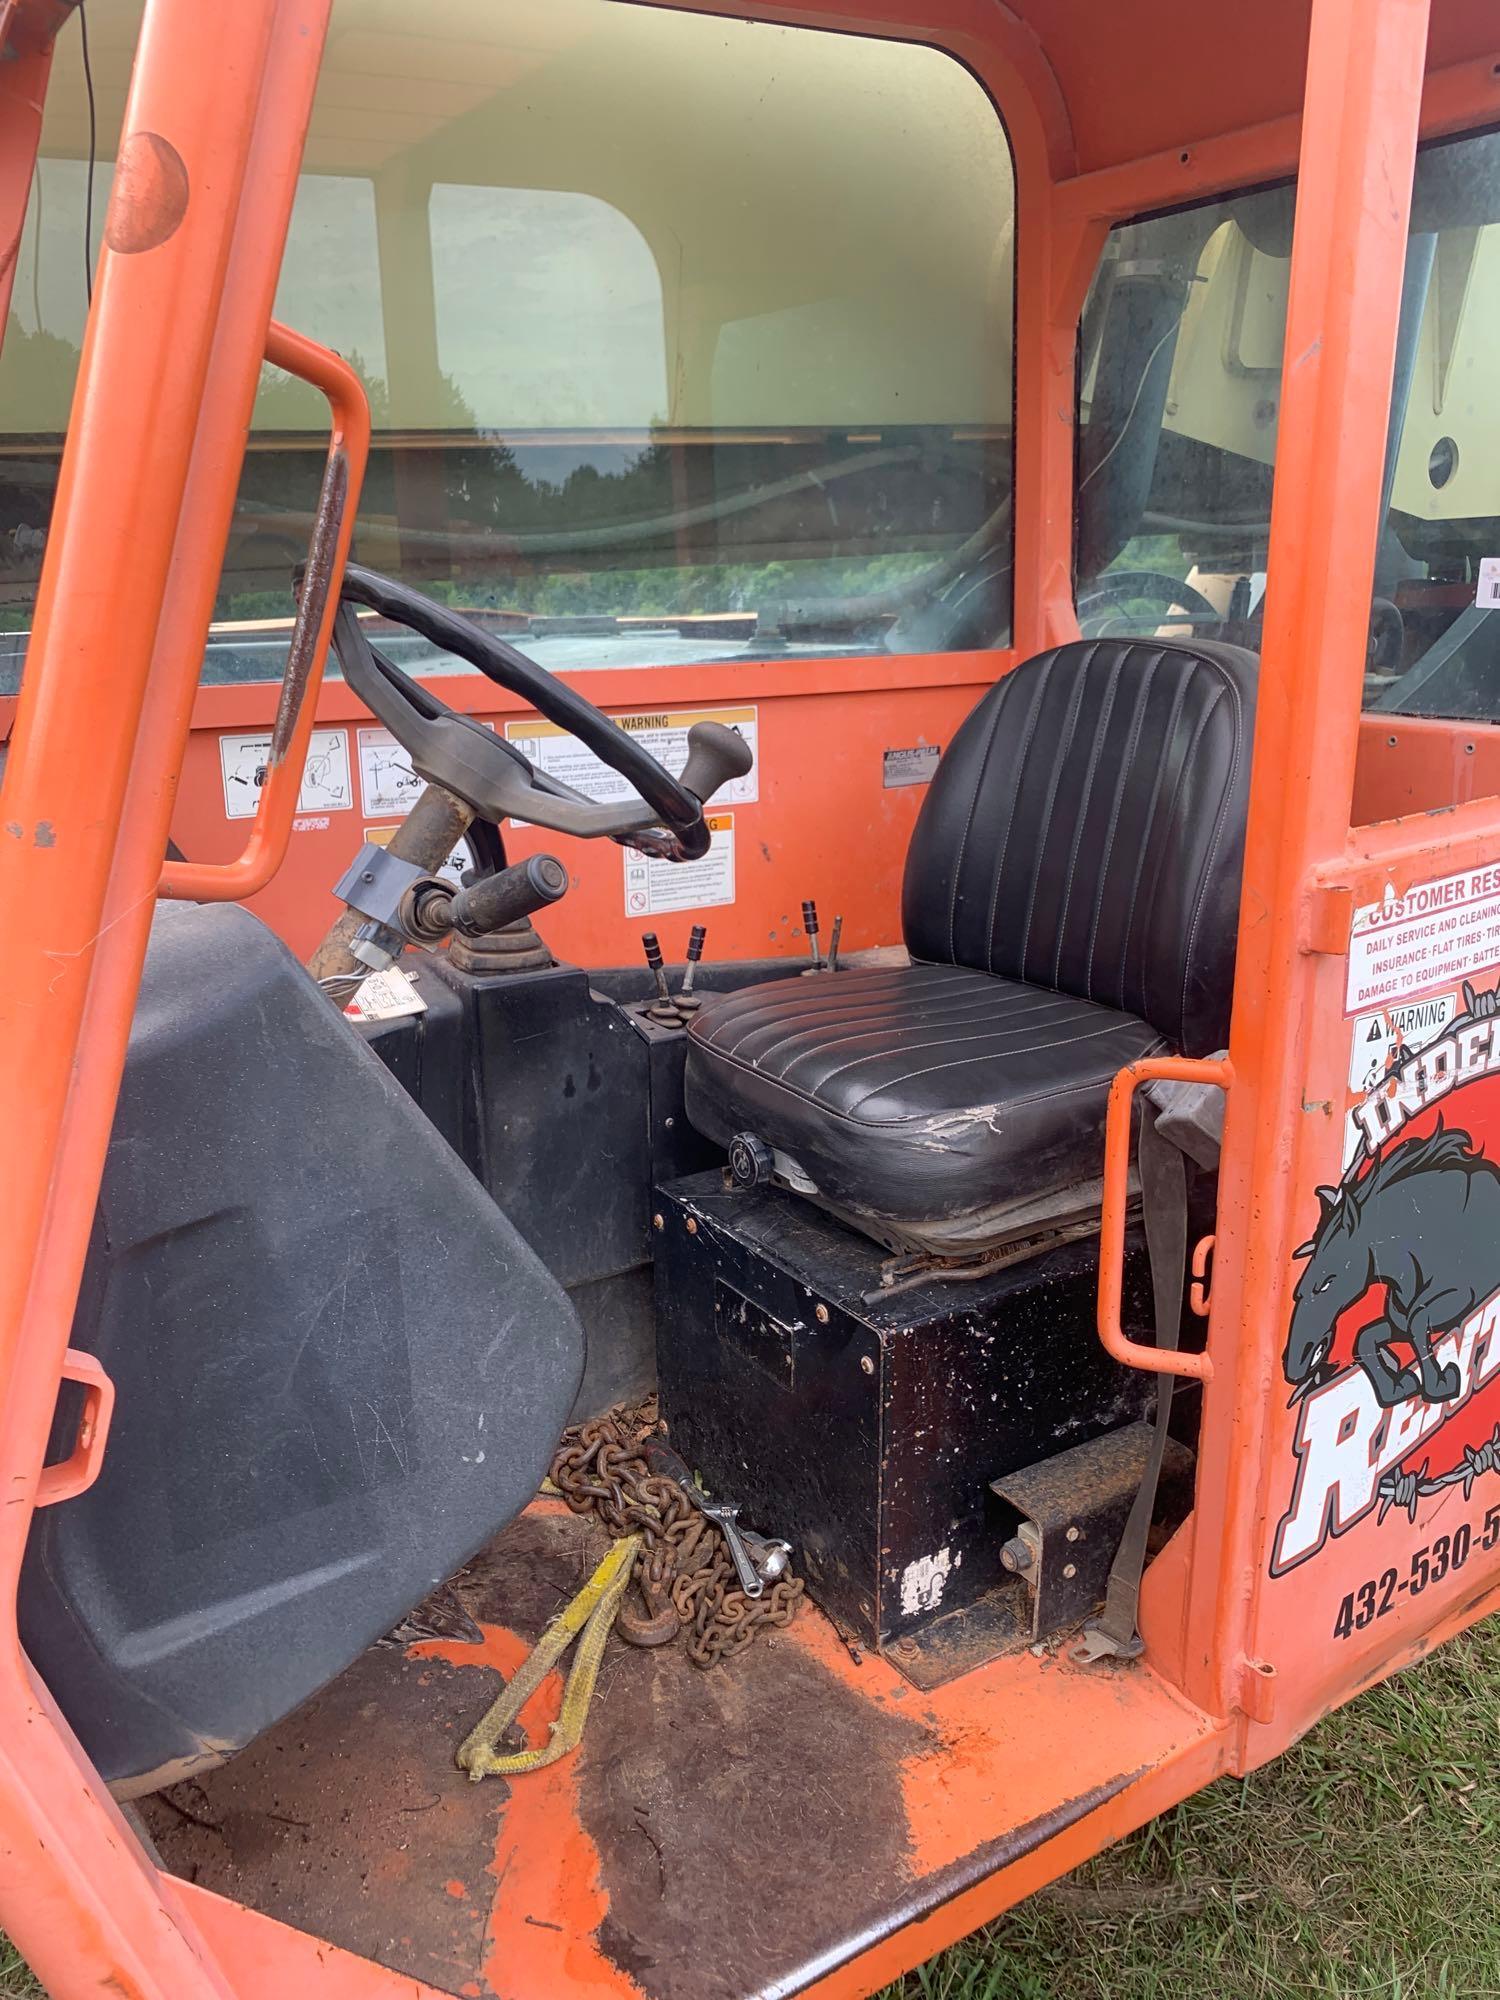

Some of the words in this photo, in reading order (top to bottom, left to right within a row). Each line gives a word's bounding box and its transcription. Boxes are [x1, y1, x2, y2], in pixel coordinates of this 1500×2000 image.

[621, 715, 669, 730] WARNING
[1368, 879, 1465, 925] CUSTOMER
[1471, 868, 1500, 896] RES
[1366, 936, 1394, 955] DAILY
[1396, 923, 1436, 946] SERVICE
[1438, 917, 1457, 932] AND
[1372, 947, 1427, 975] INSURANCE
[1432, 939, 1454, 957] FLAT
[1457, 930, 1481, 949] TIRES
[1358, 978, 1398, 1001] DAMAGE
[1401, 973, 1413, 988] TO
[1416, 955, 1468, 981] EQUIPMENT
[1386, 1001, 1446, 1037] WARNING
[1333, 1503, 1500, 1640] 432-530-5
